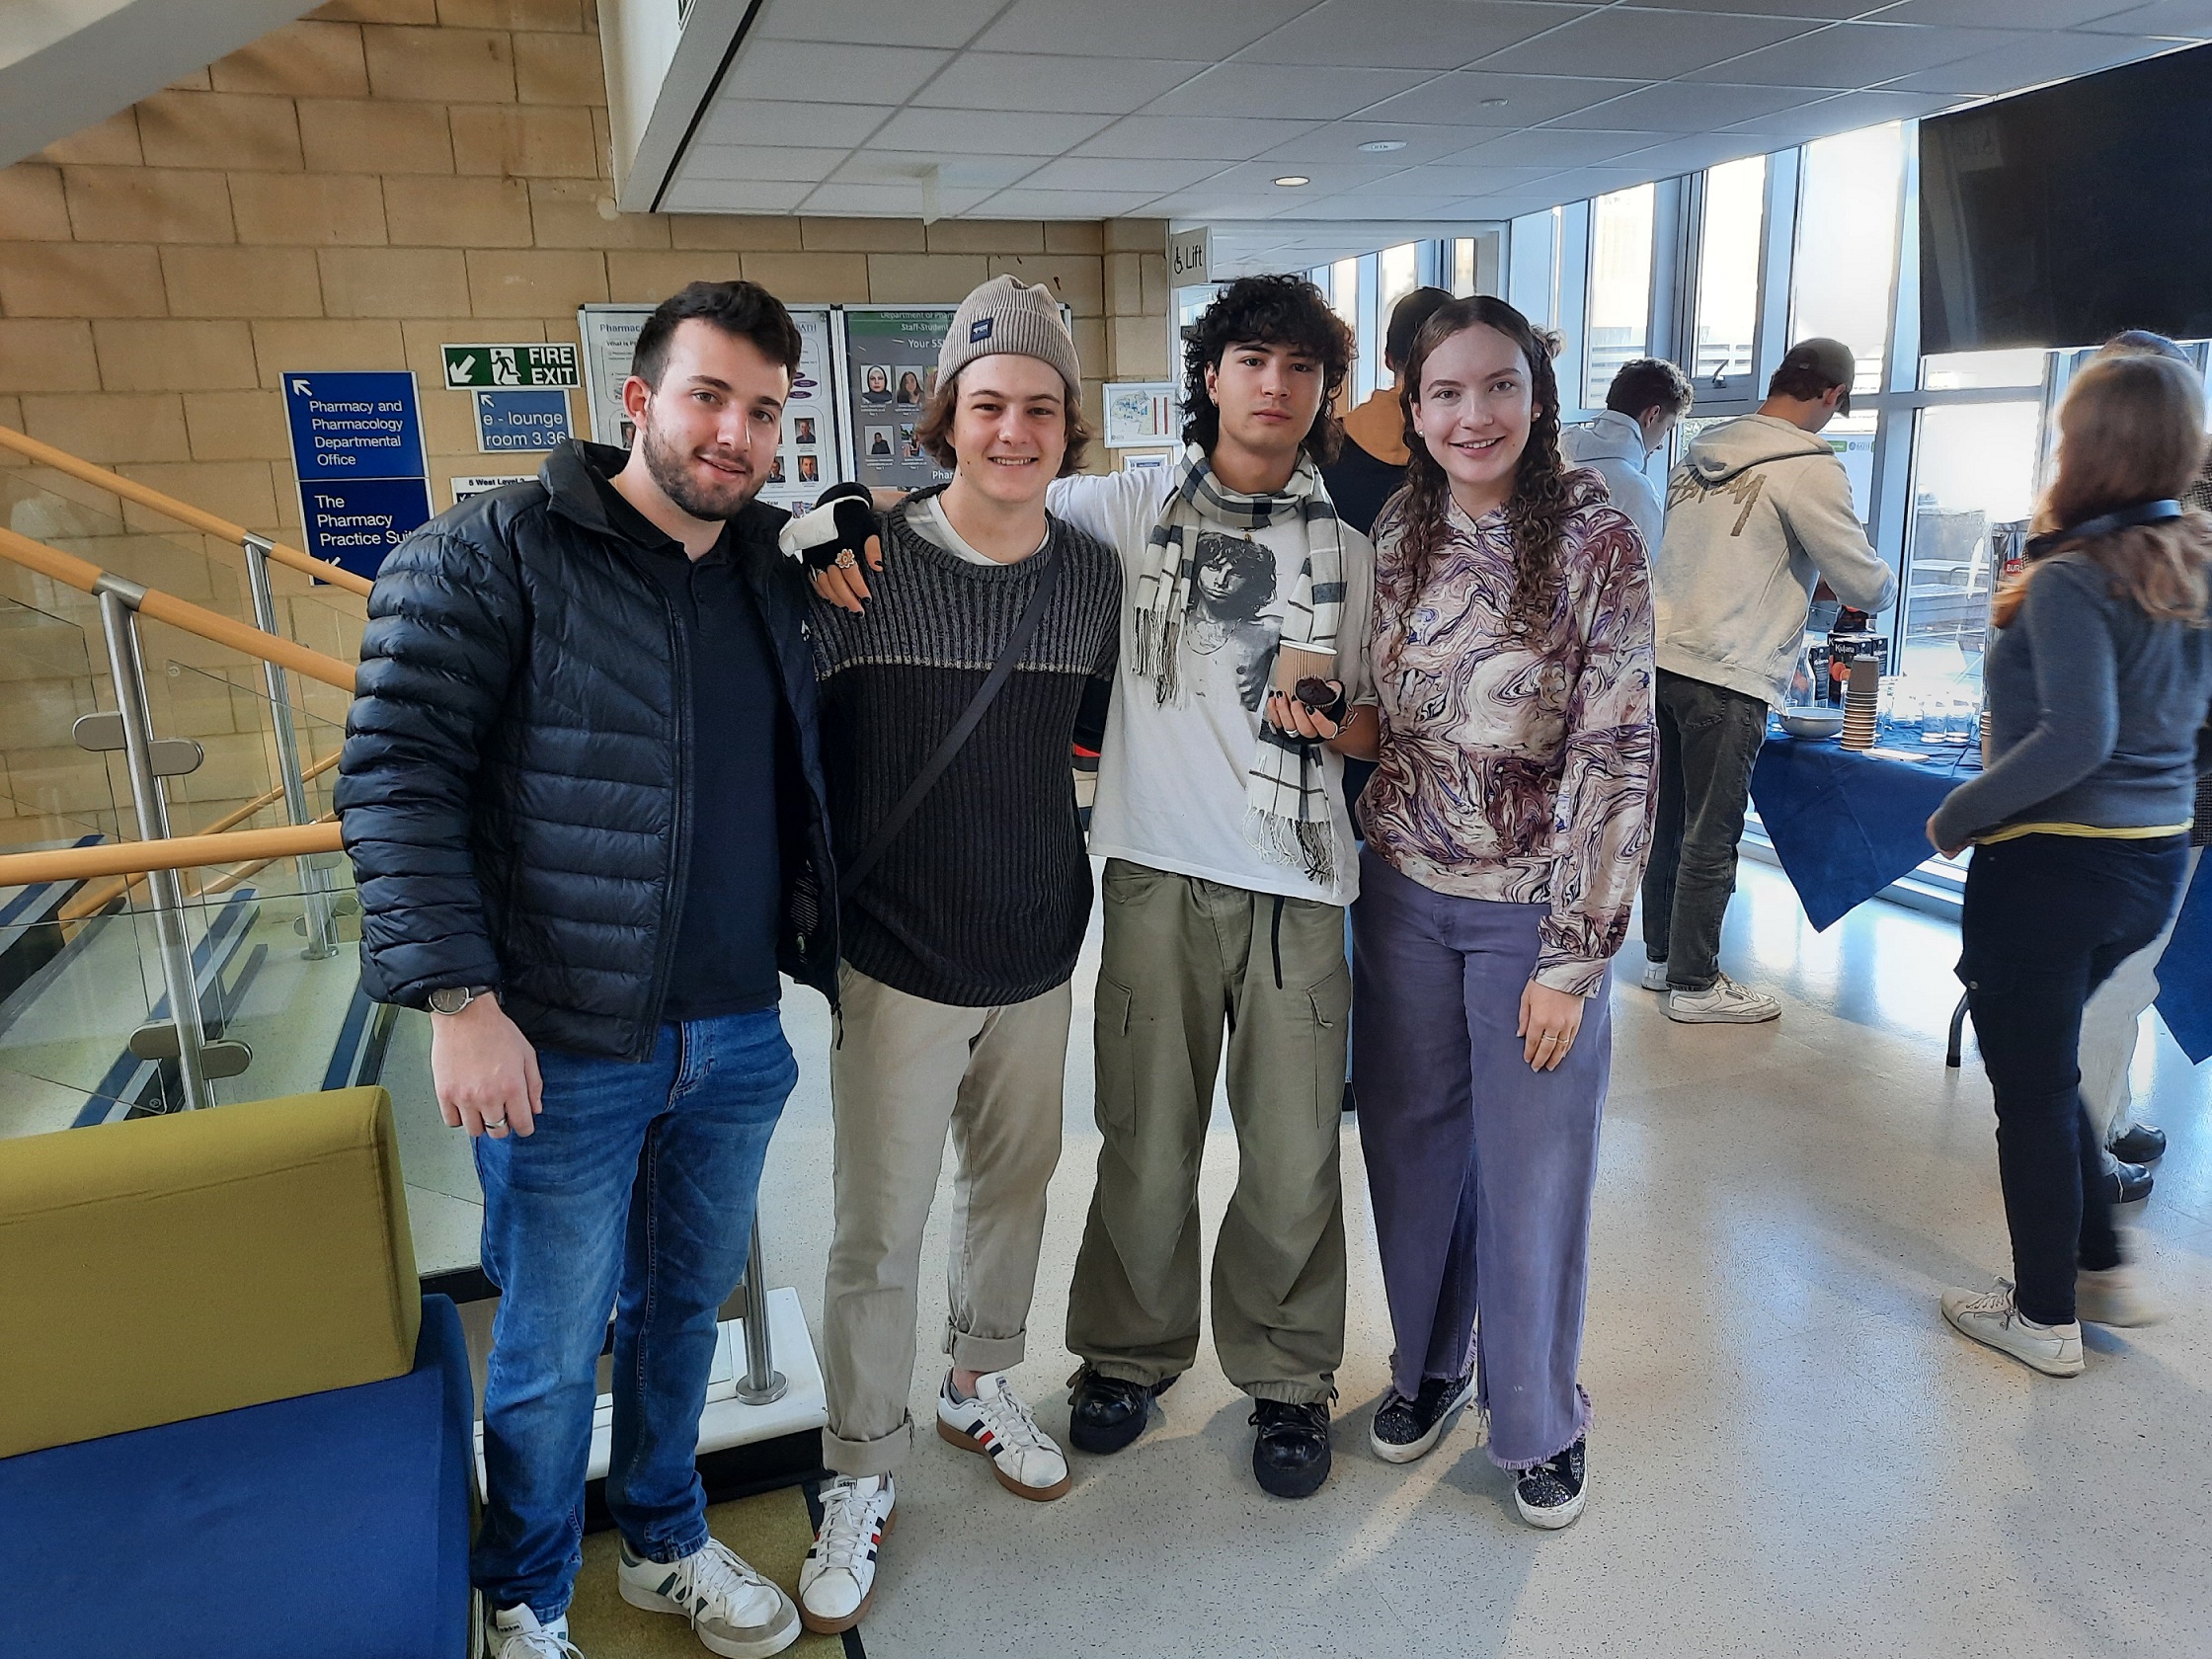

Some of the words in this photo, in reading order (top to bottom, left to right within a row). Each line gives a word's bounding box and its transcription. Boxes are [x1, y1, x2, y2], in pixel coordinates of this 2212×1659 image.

[1186, 244, 1203, 269] Lift
[880, 312, 924, 321] Department
[908, 339, 929, 349] Your
[528, 348, 573, 365] FIRE
[531, 367, 574, 385] EXIT
[309, 400, 374, 415] Pharmacy
[377, 400, 403, 412] and
[311, 418, 403, 433] Pharmacology
[483, 414, 493, 426] e
[508, 411, 563, 428] lounge
[314, 435, 402, 450] Departmental
[486, 434, 527, 446] room
[531, 431, 567, 445] 3.36
[316, 453, 356, 466] Office
[314, 495, 346, 509] The
[316, 514, 393, 528] Pharmacy
[319, 531, 381, 547] Practice
